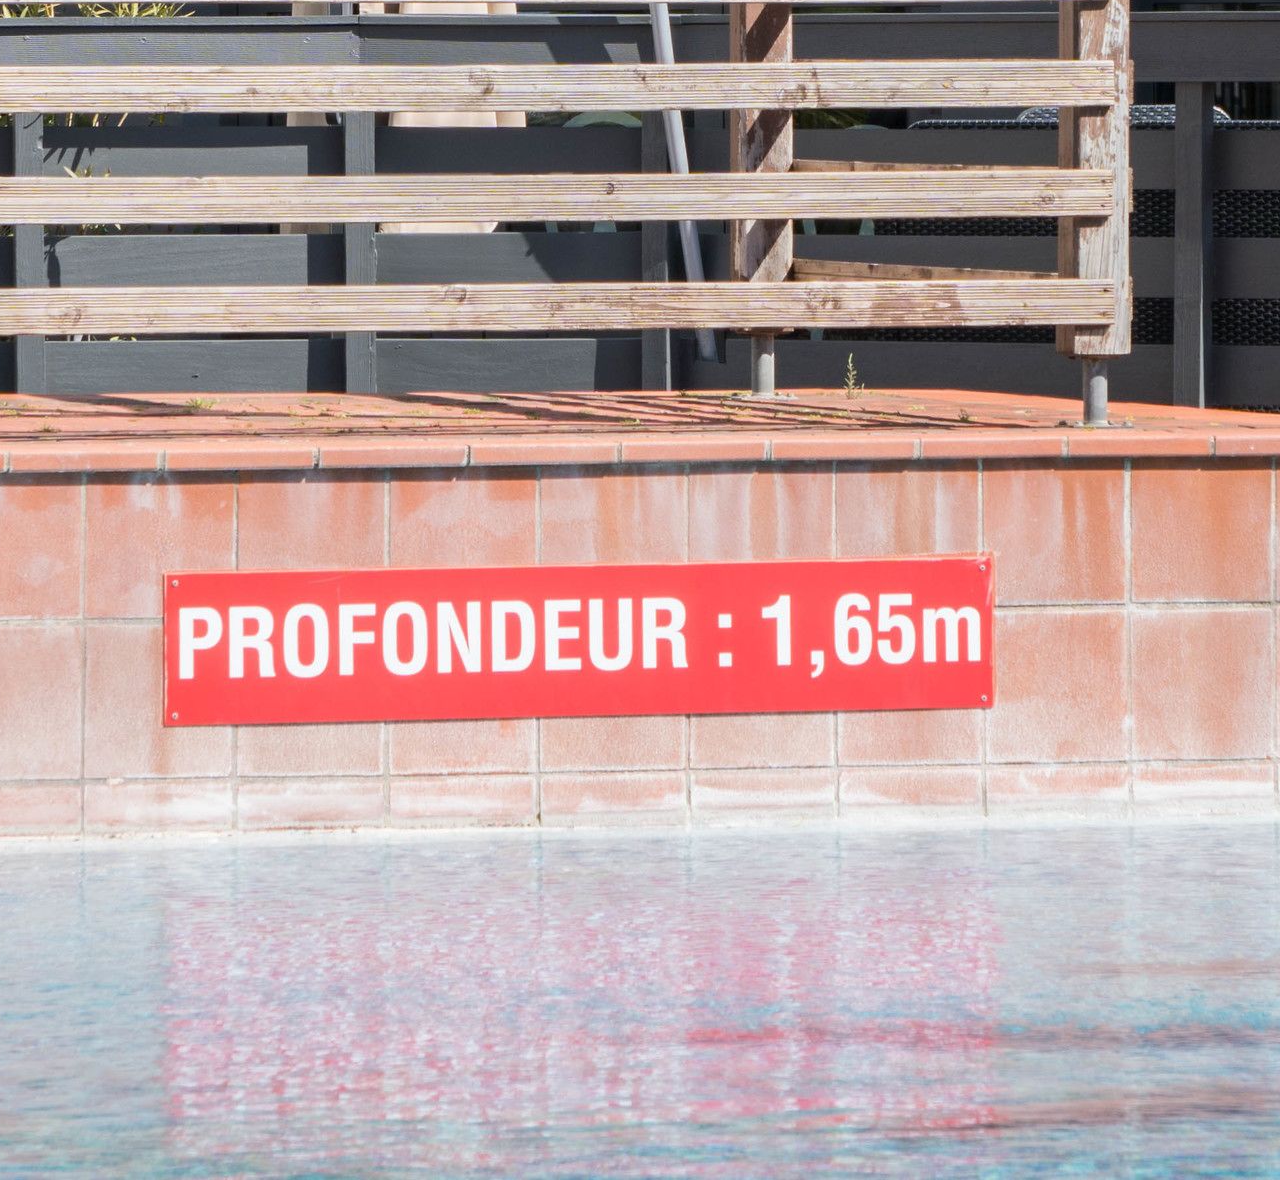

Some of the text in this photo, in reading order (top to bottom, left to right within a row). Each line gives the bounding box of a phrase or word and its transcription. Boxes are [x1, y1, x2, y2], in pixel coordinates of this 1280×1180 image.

[178, 593, 981, 680] PROFONDEUR : 1,65m
